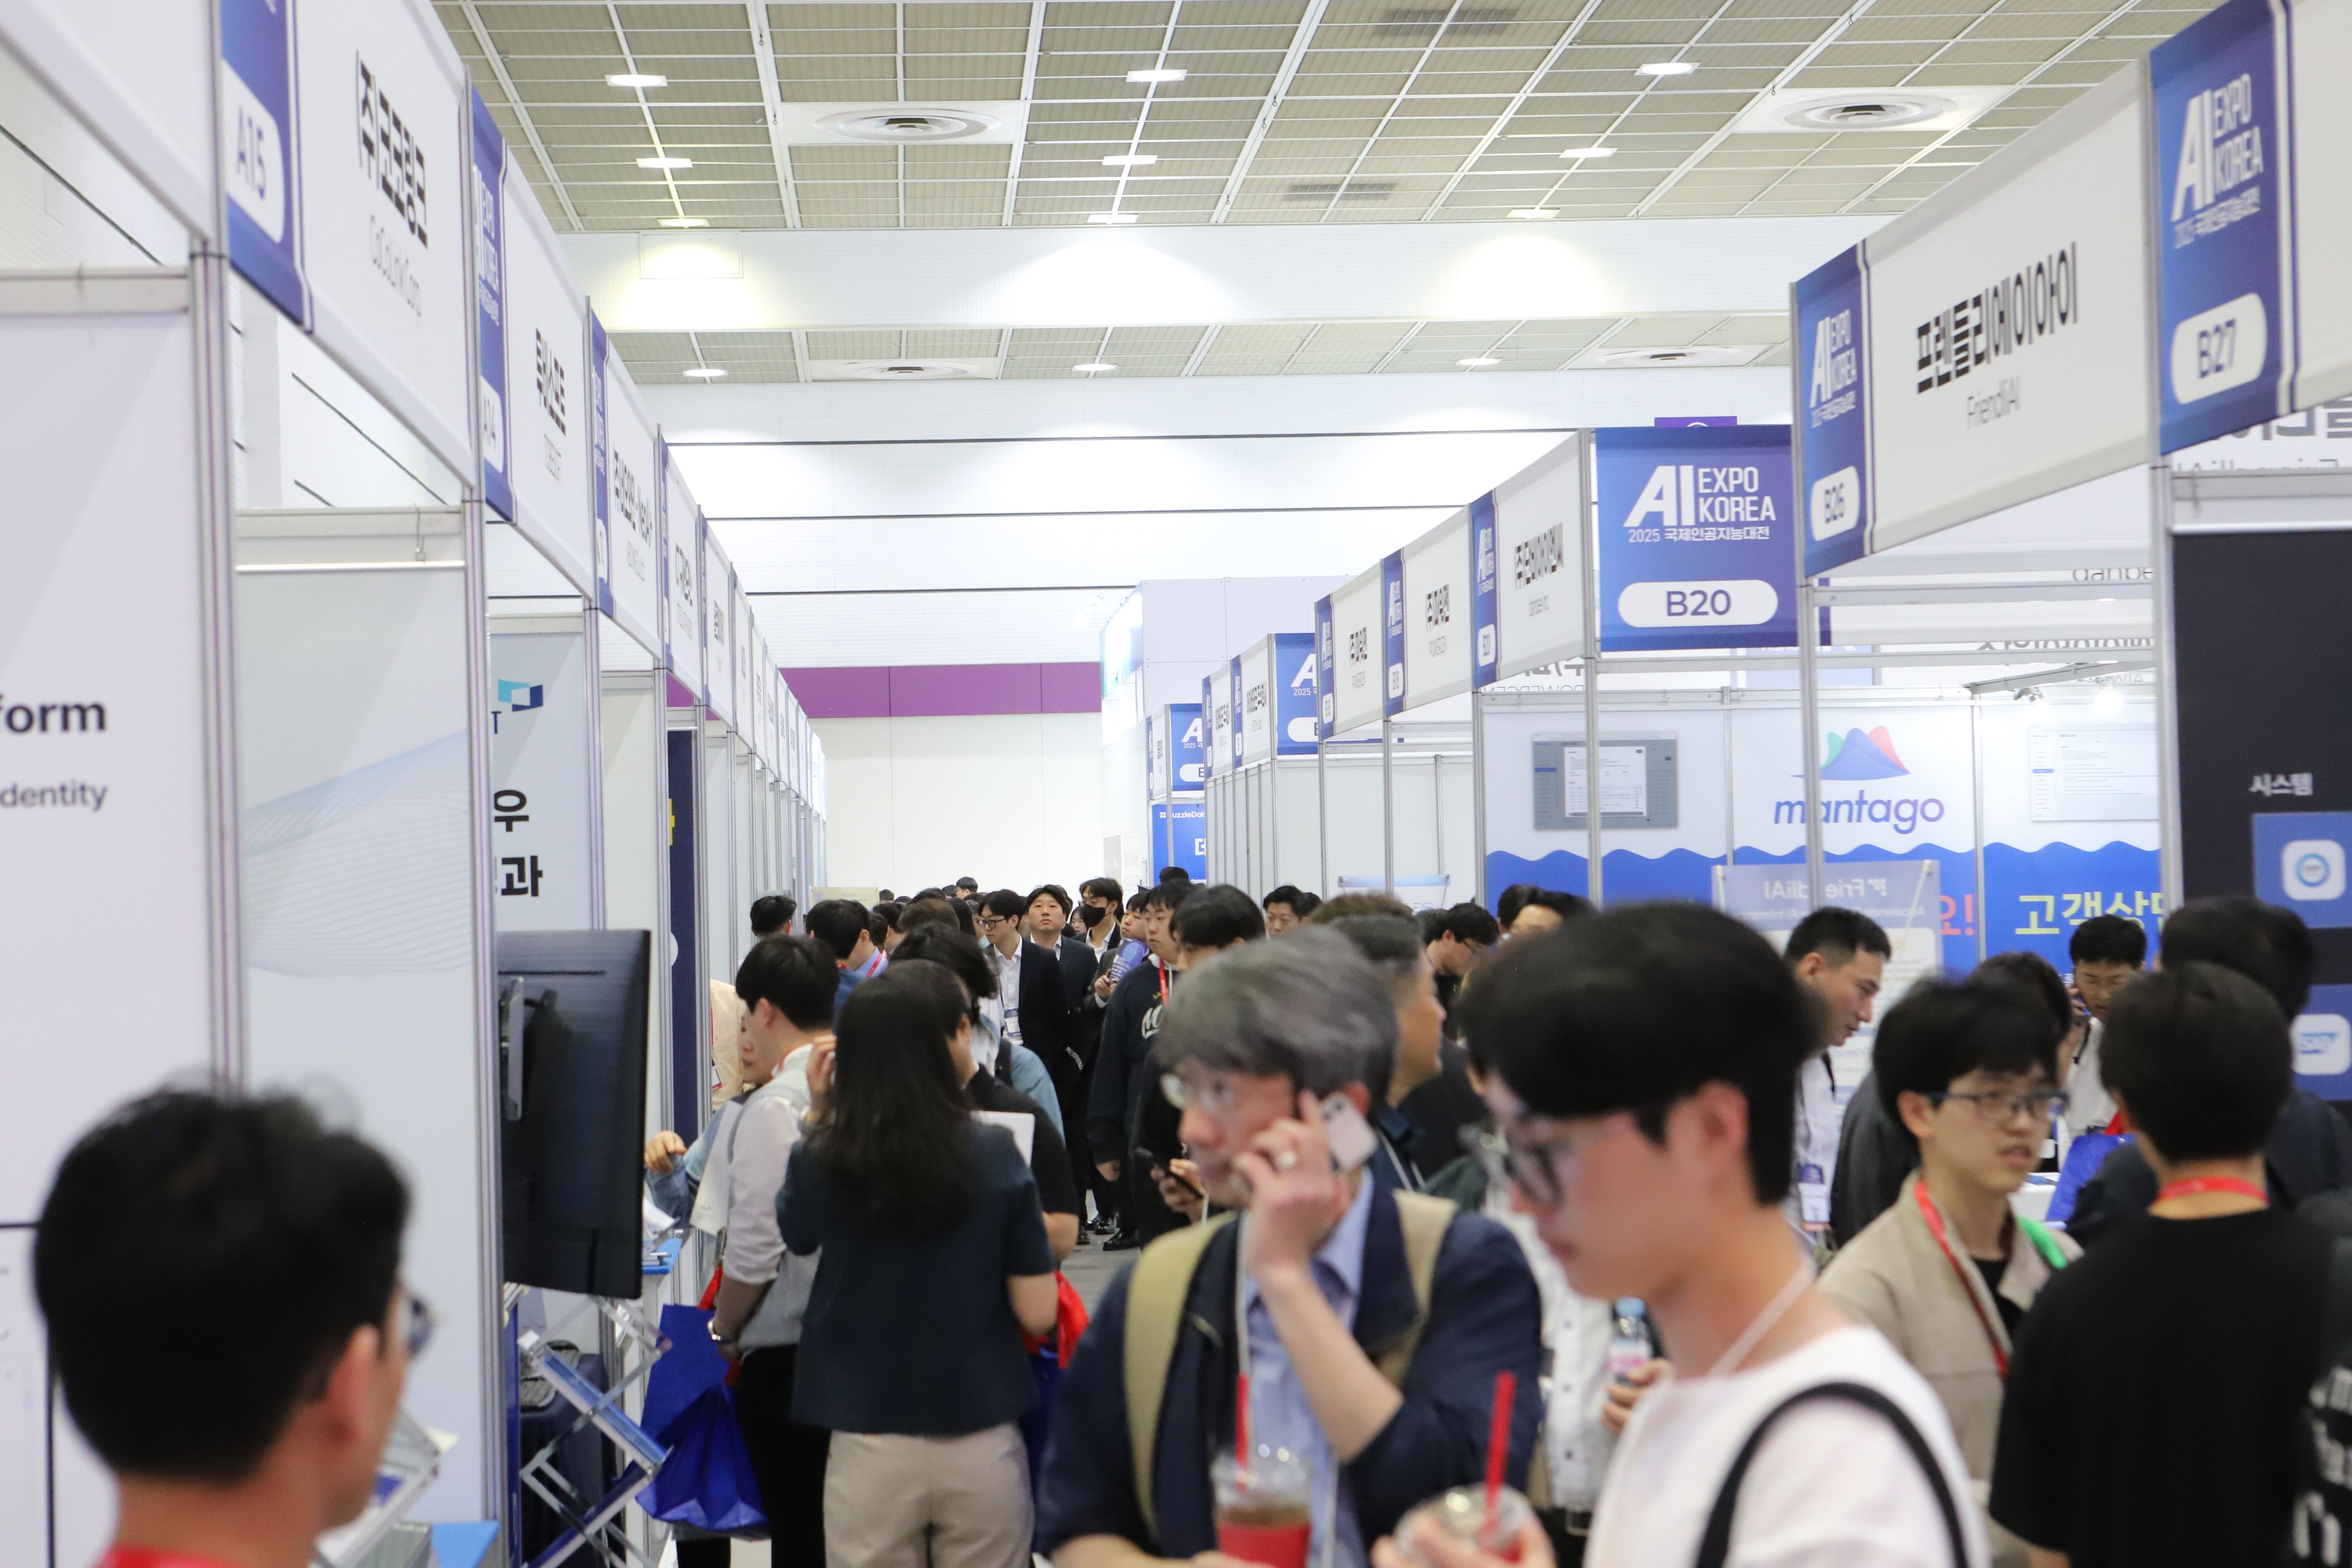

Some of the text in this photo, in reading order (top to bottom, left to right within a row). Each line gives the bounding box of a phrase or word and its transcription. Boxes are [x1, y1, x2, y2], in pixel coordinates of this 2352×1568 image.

[237, 106, 266, 201] A15
[2171, 89, 2215, 222] AI
[2213, 73, 2252, 138] EXPO
[2214, 125, 2264, 194] KOREA
[1917, 241, 2078, 394] 프렌들리에이아이
[1810, 316, 1832, 408] AI
[2198, 317, 2236, 379] B27
[1623, 465, 1759, 527] AI EXPO
[1699, 496, 1776, 523] KOREA
[1824, 482, 1845, 524] B26
[1629, 526, 1770, 543] 2025 국제인공지능대전
[1667, 589, 1731, 616] B20
[1291, 654, 1317, 687] A
[0, 694, 106, 733] orm
[1181, 718, 1203, 742] A
[0, 779, 108, 812] dentity
[2249, 772, 2314, 796] 시스템
